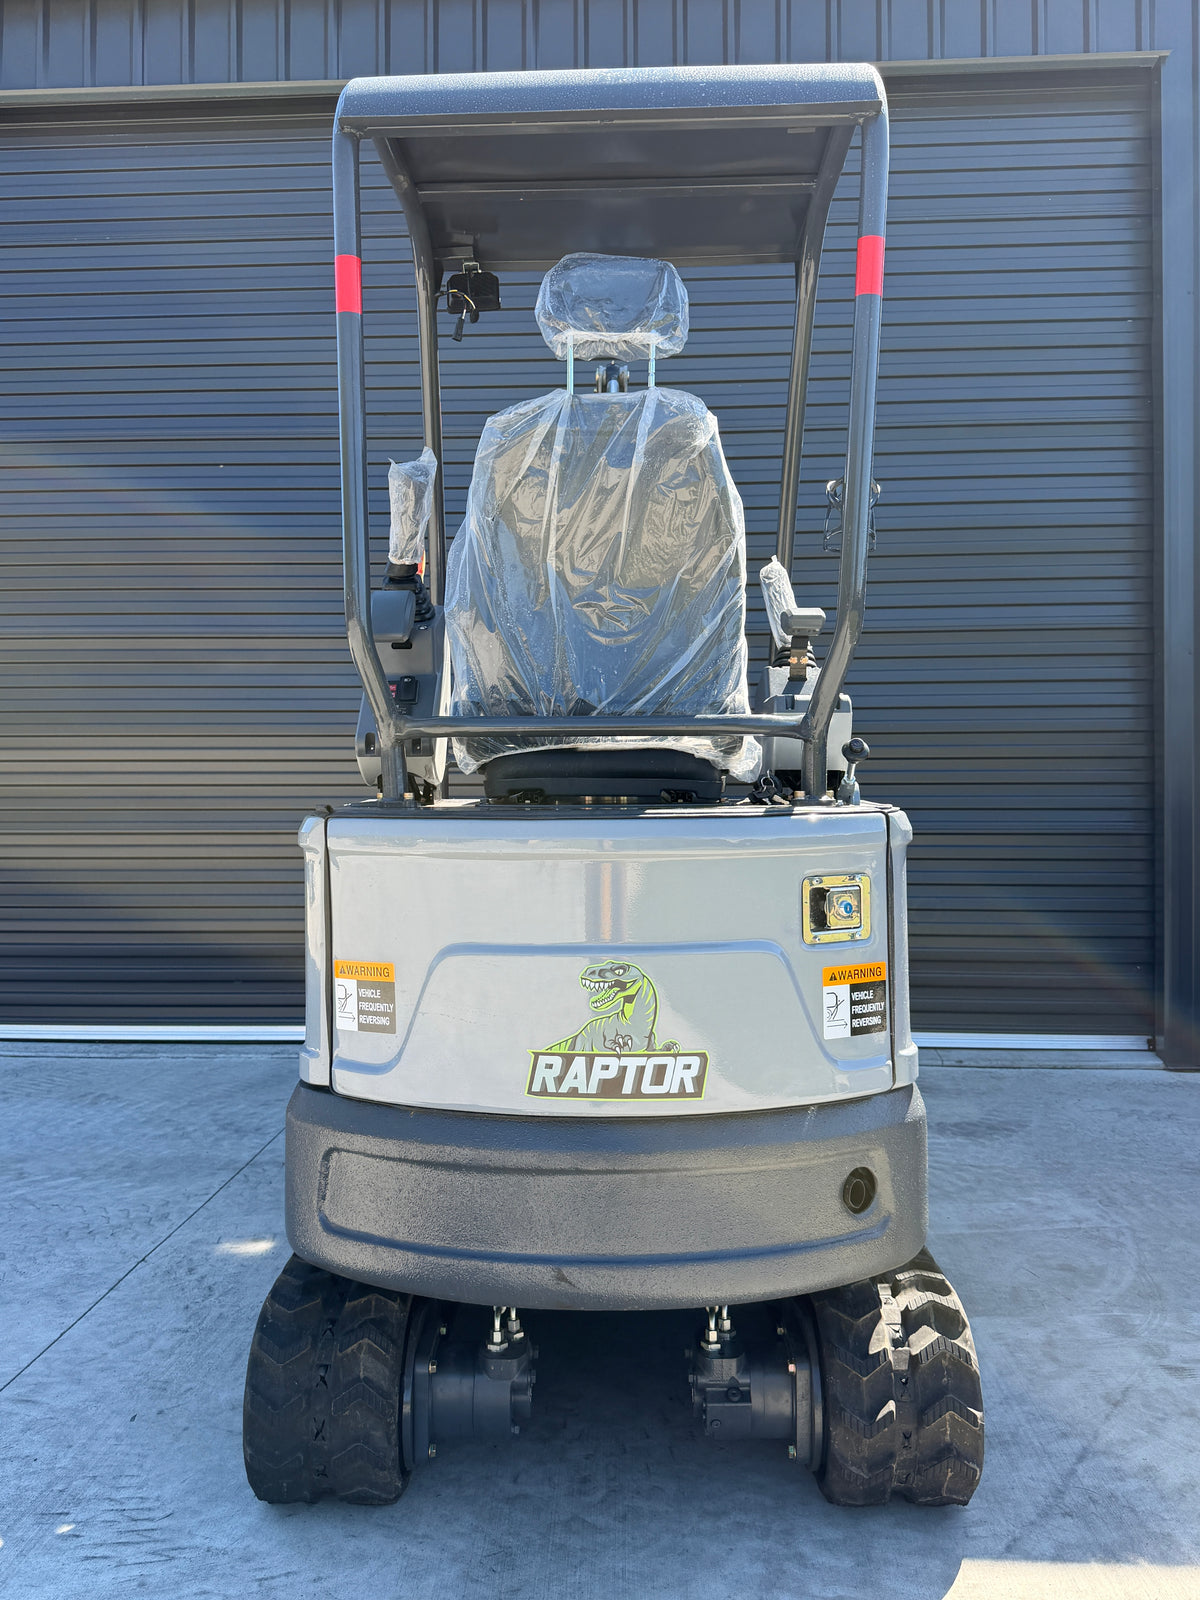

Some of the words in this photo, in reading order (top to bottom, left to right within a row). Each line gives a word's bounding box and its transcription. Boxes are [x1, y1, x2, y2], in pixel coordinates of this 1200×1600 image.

[346, 965, 390, 977] WARNING
[838, 967, 882, 980] WARNING
[358, 988, 381, 998] VEHICLE
[851, 990, 874, 1000] VEHICLE
[358, 1001, 394, 1012] FREQUENTLY
[851, 1002, 885, 1014] FREQUENTLY
[359, 1014, 390, 1026] REVERSING
[851, 1016, 882, 1028] REVERSING
[531, 1055, 701, 1095] RAPTOR
